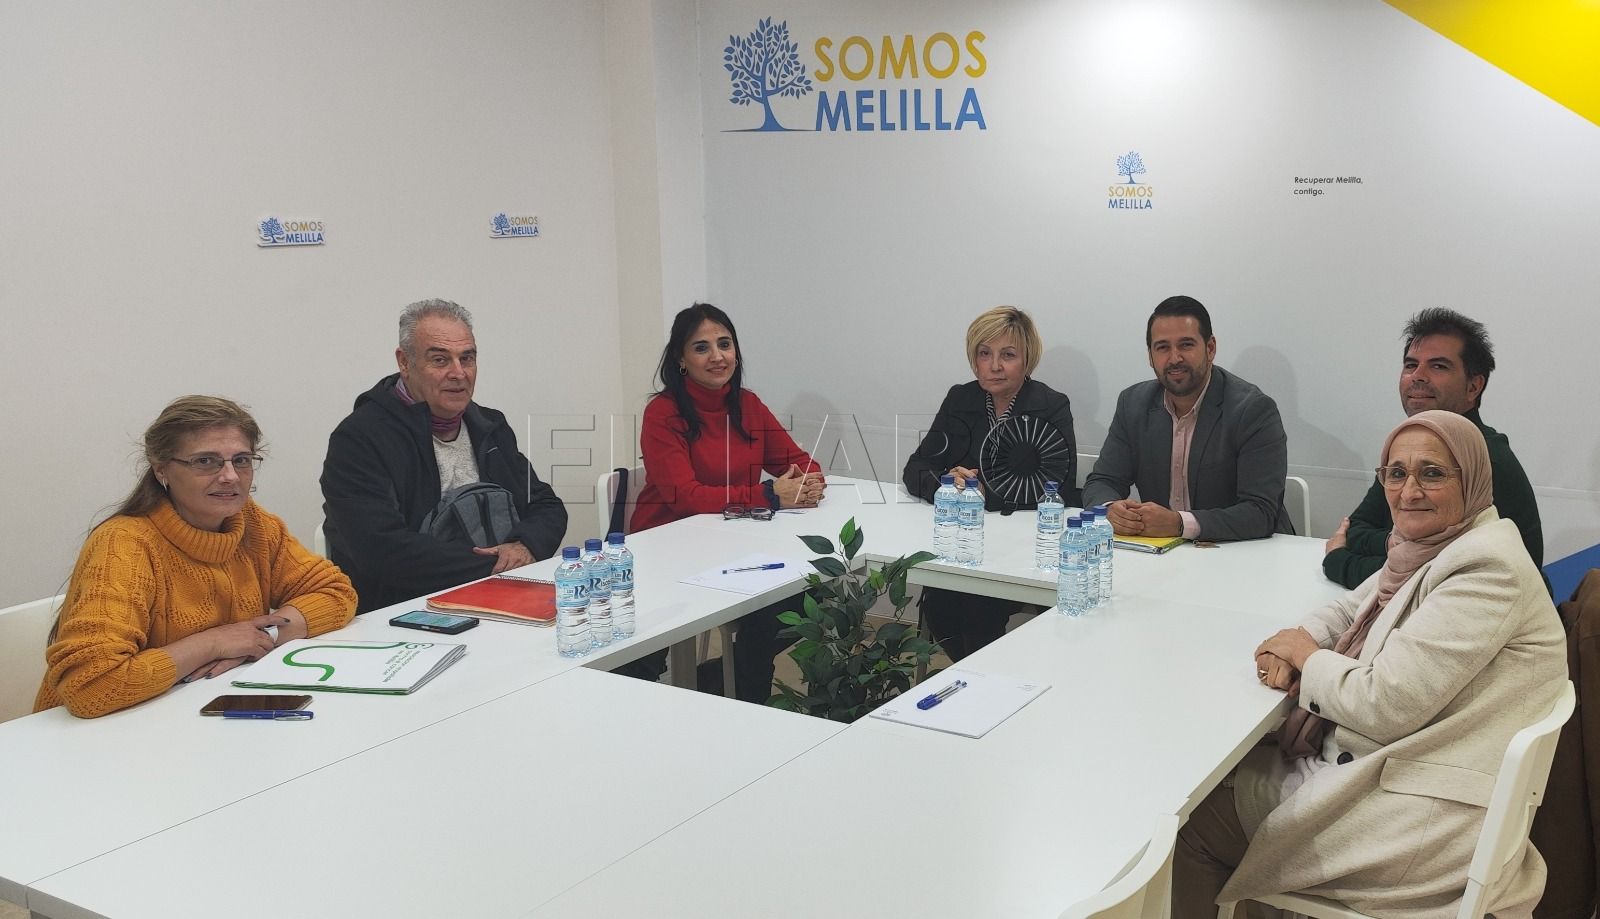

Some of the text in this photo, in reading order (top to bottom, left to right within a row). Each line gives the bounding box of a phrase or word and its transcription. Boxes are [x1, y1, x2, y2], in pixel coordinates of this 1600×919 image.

[814, 30, 988, 82] SOMOS
[816, 87, 987, 131] MELILLA
[1294, 176, 1334, 185] Recuperar
[1108, 186, 1153, 197] SOMOS
[1293, 188, 1325, 196] contigo.
[1108, 198, 1153, 209] MELILLA
[284, 221, 323, 232] SOMOS
[511, 216, 538, 226] SOMOS
[511, 226, 539, 235] MELILLA
[285, 232, 324, 243] MELILLA
